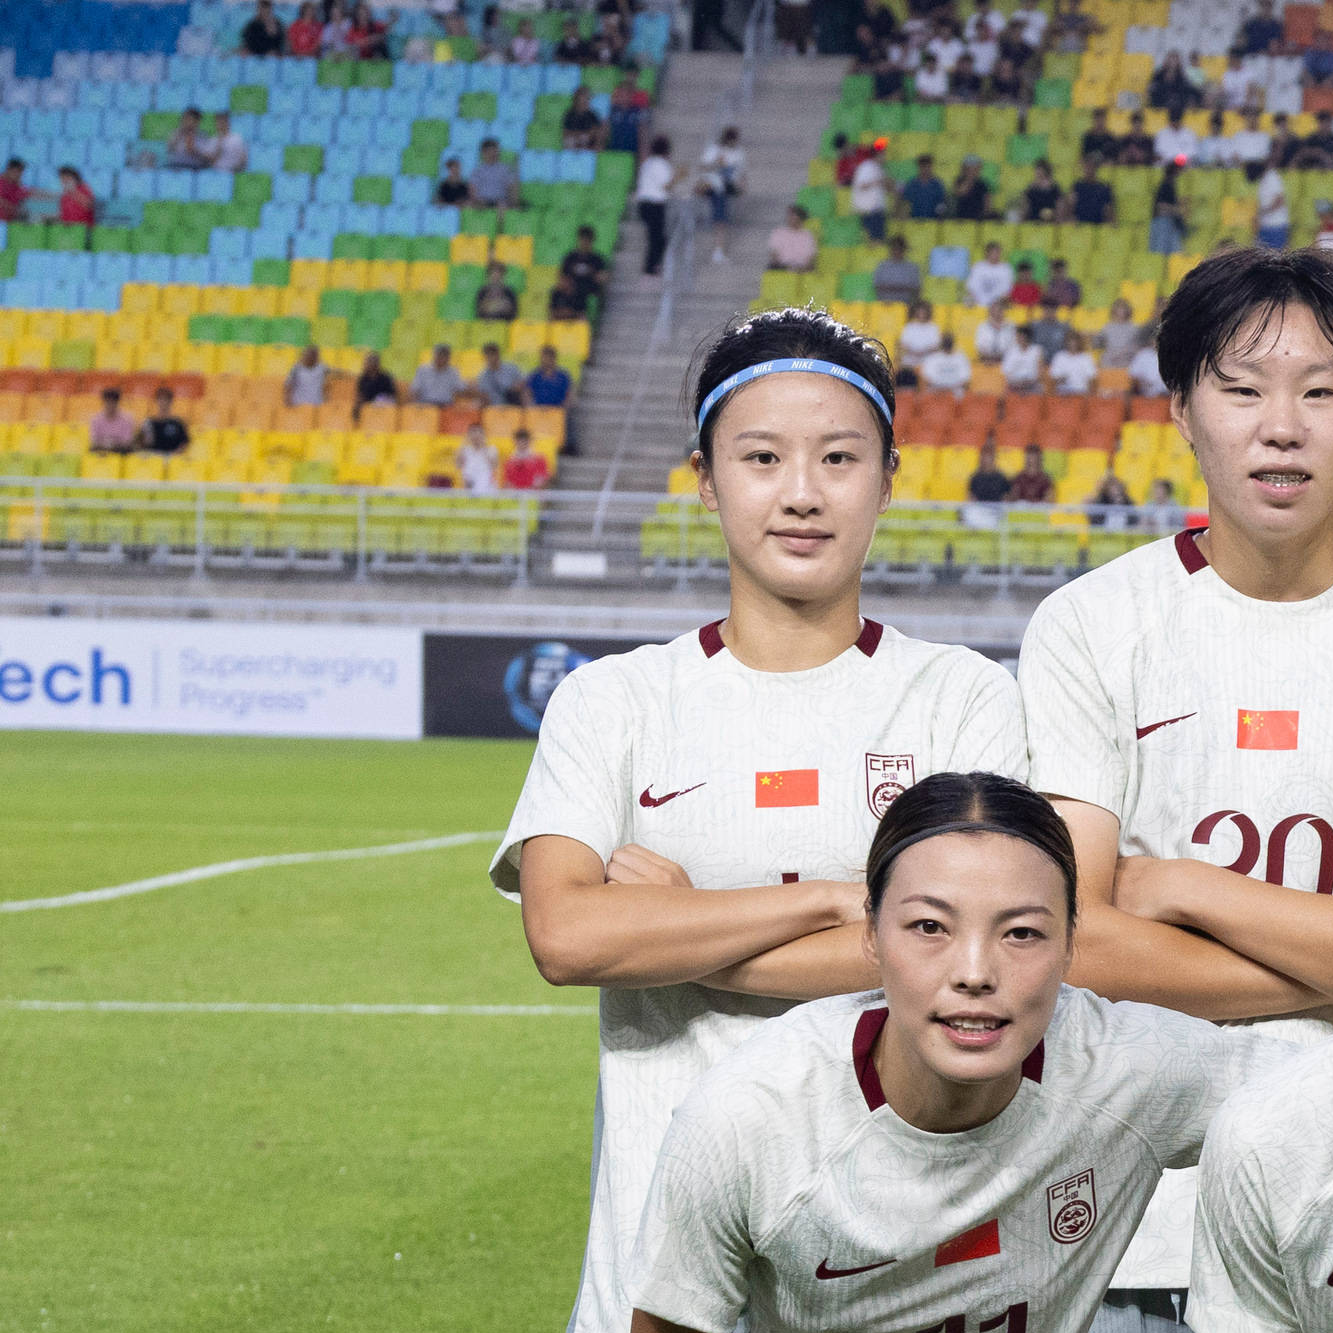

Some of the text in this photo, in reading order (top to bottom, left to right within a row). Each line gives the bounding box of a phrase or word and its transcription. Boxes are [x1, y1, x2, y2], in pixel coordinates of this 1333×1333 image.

[752, 362, 774, 375] NIKE
[791, 360, 814, 370] NIKE
[830, 365, 850, 379] NIKE
[0, 646, 132, 705] ech
[869, 758, 909, 771] CFA
[1051, 1174, 1090, 1201] CFA
